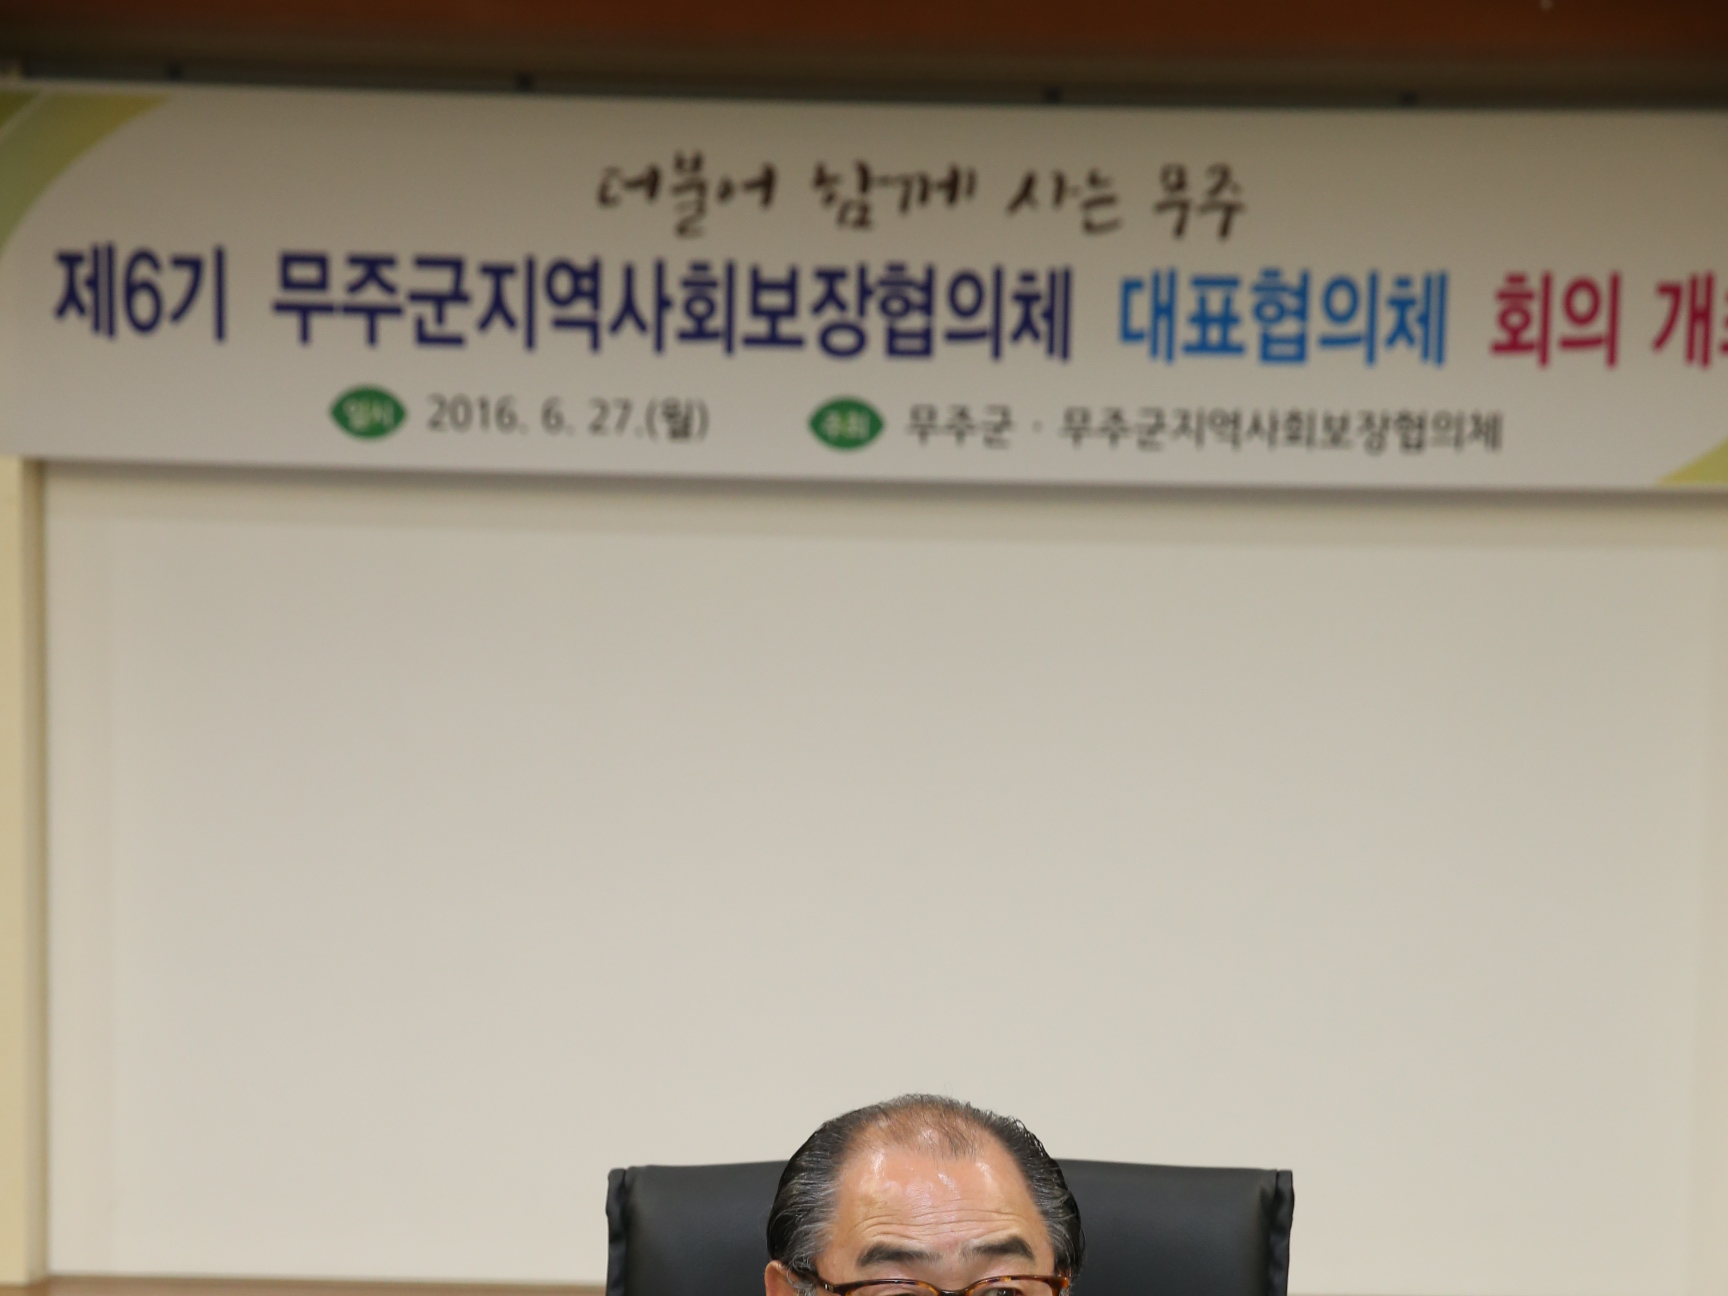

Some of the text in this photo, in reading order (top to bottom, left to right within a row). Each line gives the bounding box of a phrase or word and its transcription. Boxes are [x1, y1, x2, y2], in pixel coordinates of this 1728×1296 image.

[597, 150, 1247, 241] 더불어 함께 사는 무주
[54, 242, 1728, 371] 제6기 무주군지역사회보장협의체 대표협의체 회의 개
[427, 393, 530, 435] 2016.
[541, 396, 576, 437] 6.
[904, 402, 1504, 455] 무주군 무주군지역사회보장협의체
